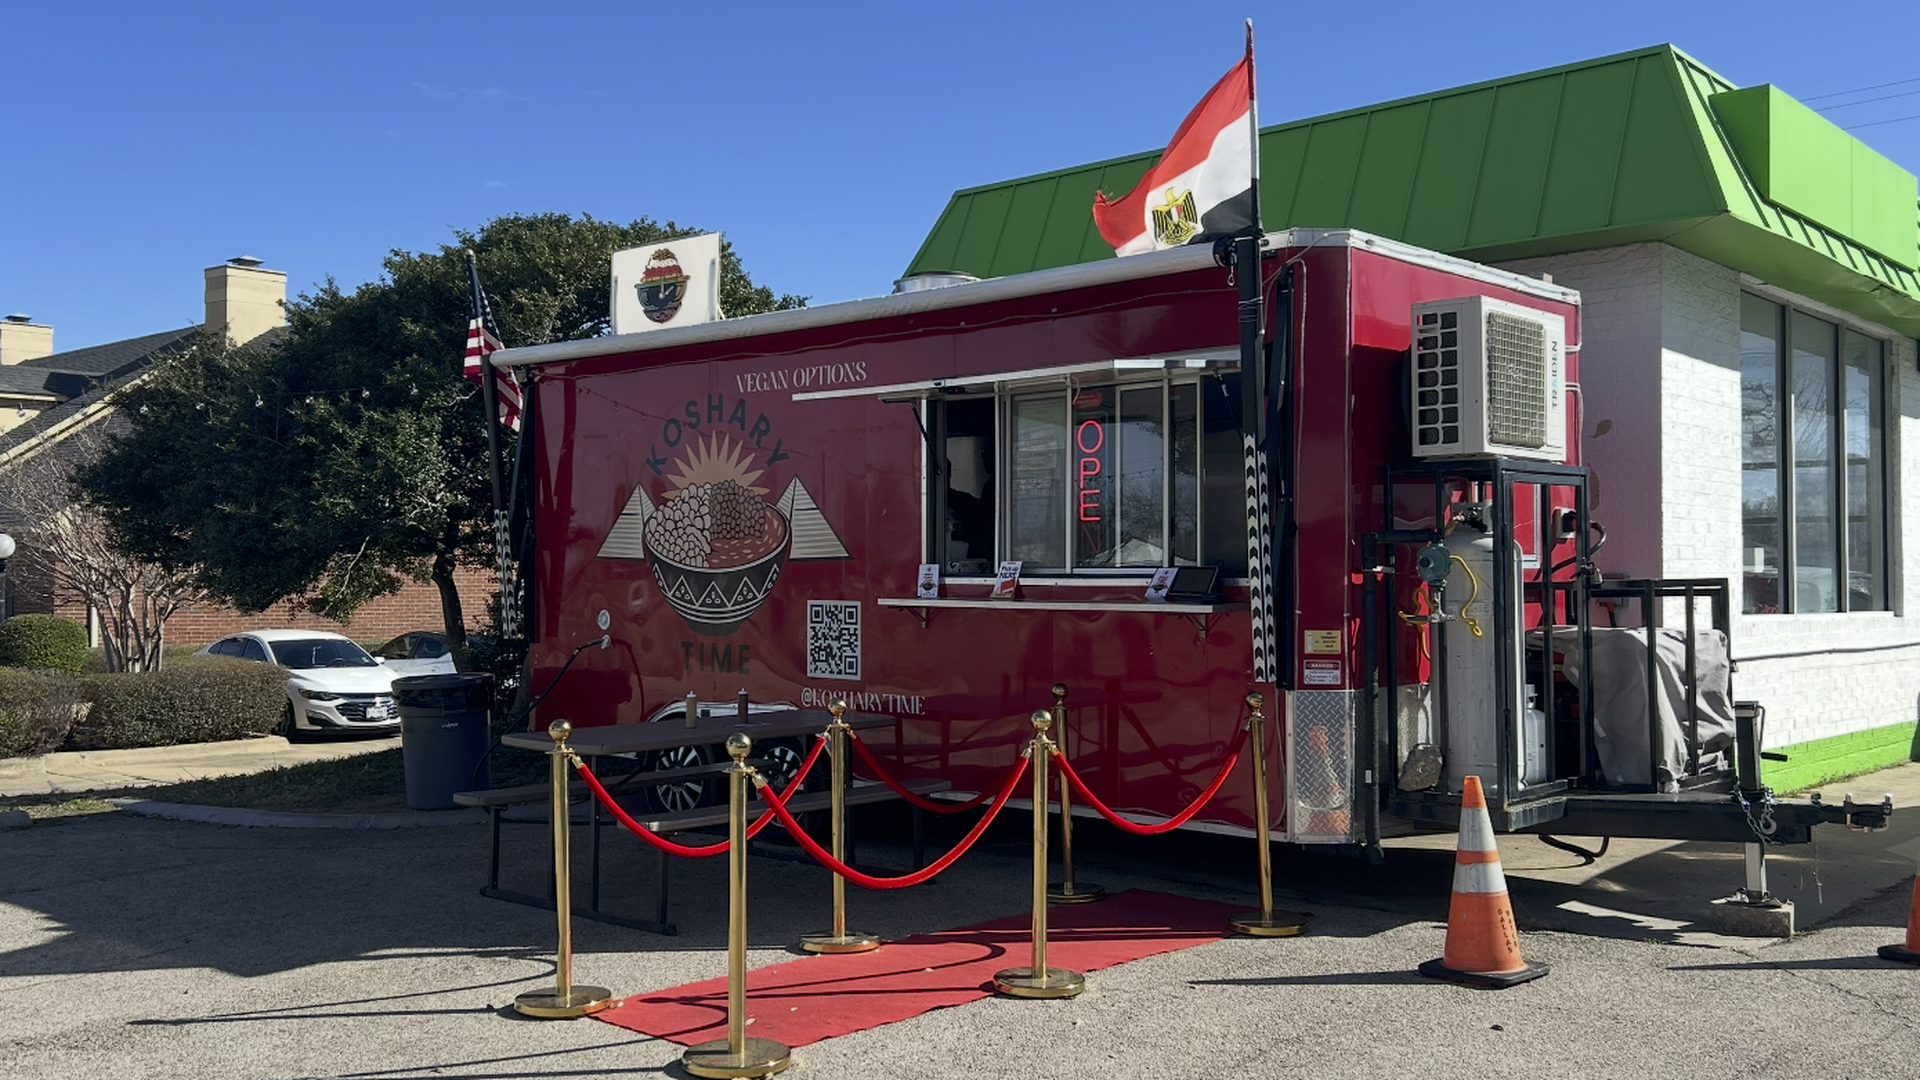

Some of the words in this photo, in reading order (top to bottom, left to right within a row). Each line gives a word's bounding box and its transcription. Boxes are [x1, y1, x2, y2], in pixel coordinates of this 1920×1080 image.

[736, 369, 788, 393] VEGAN
[793, 361, 867, 388] OPTIONS
[645, 393, 790, 476] KOSHARY
[1077, 419, 1103, 553] OPEN
[680, 641, 751, 674] TIME
[1497, 908, 1513, 953] DALLAS
